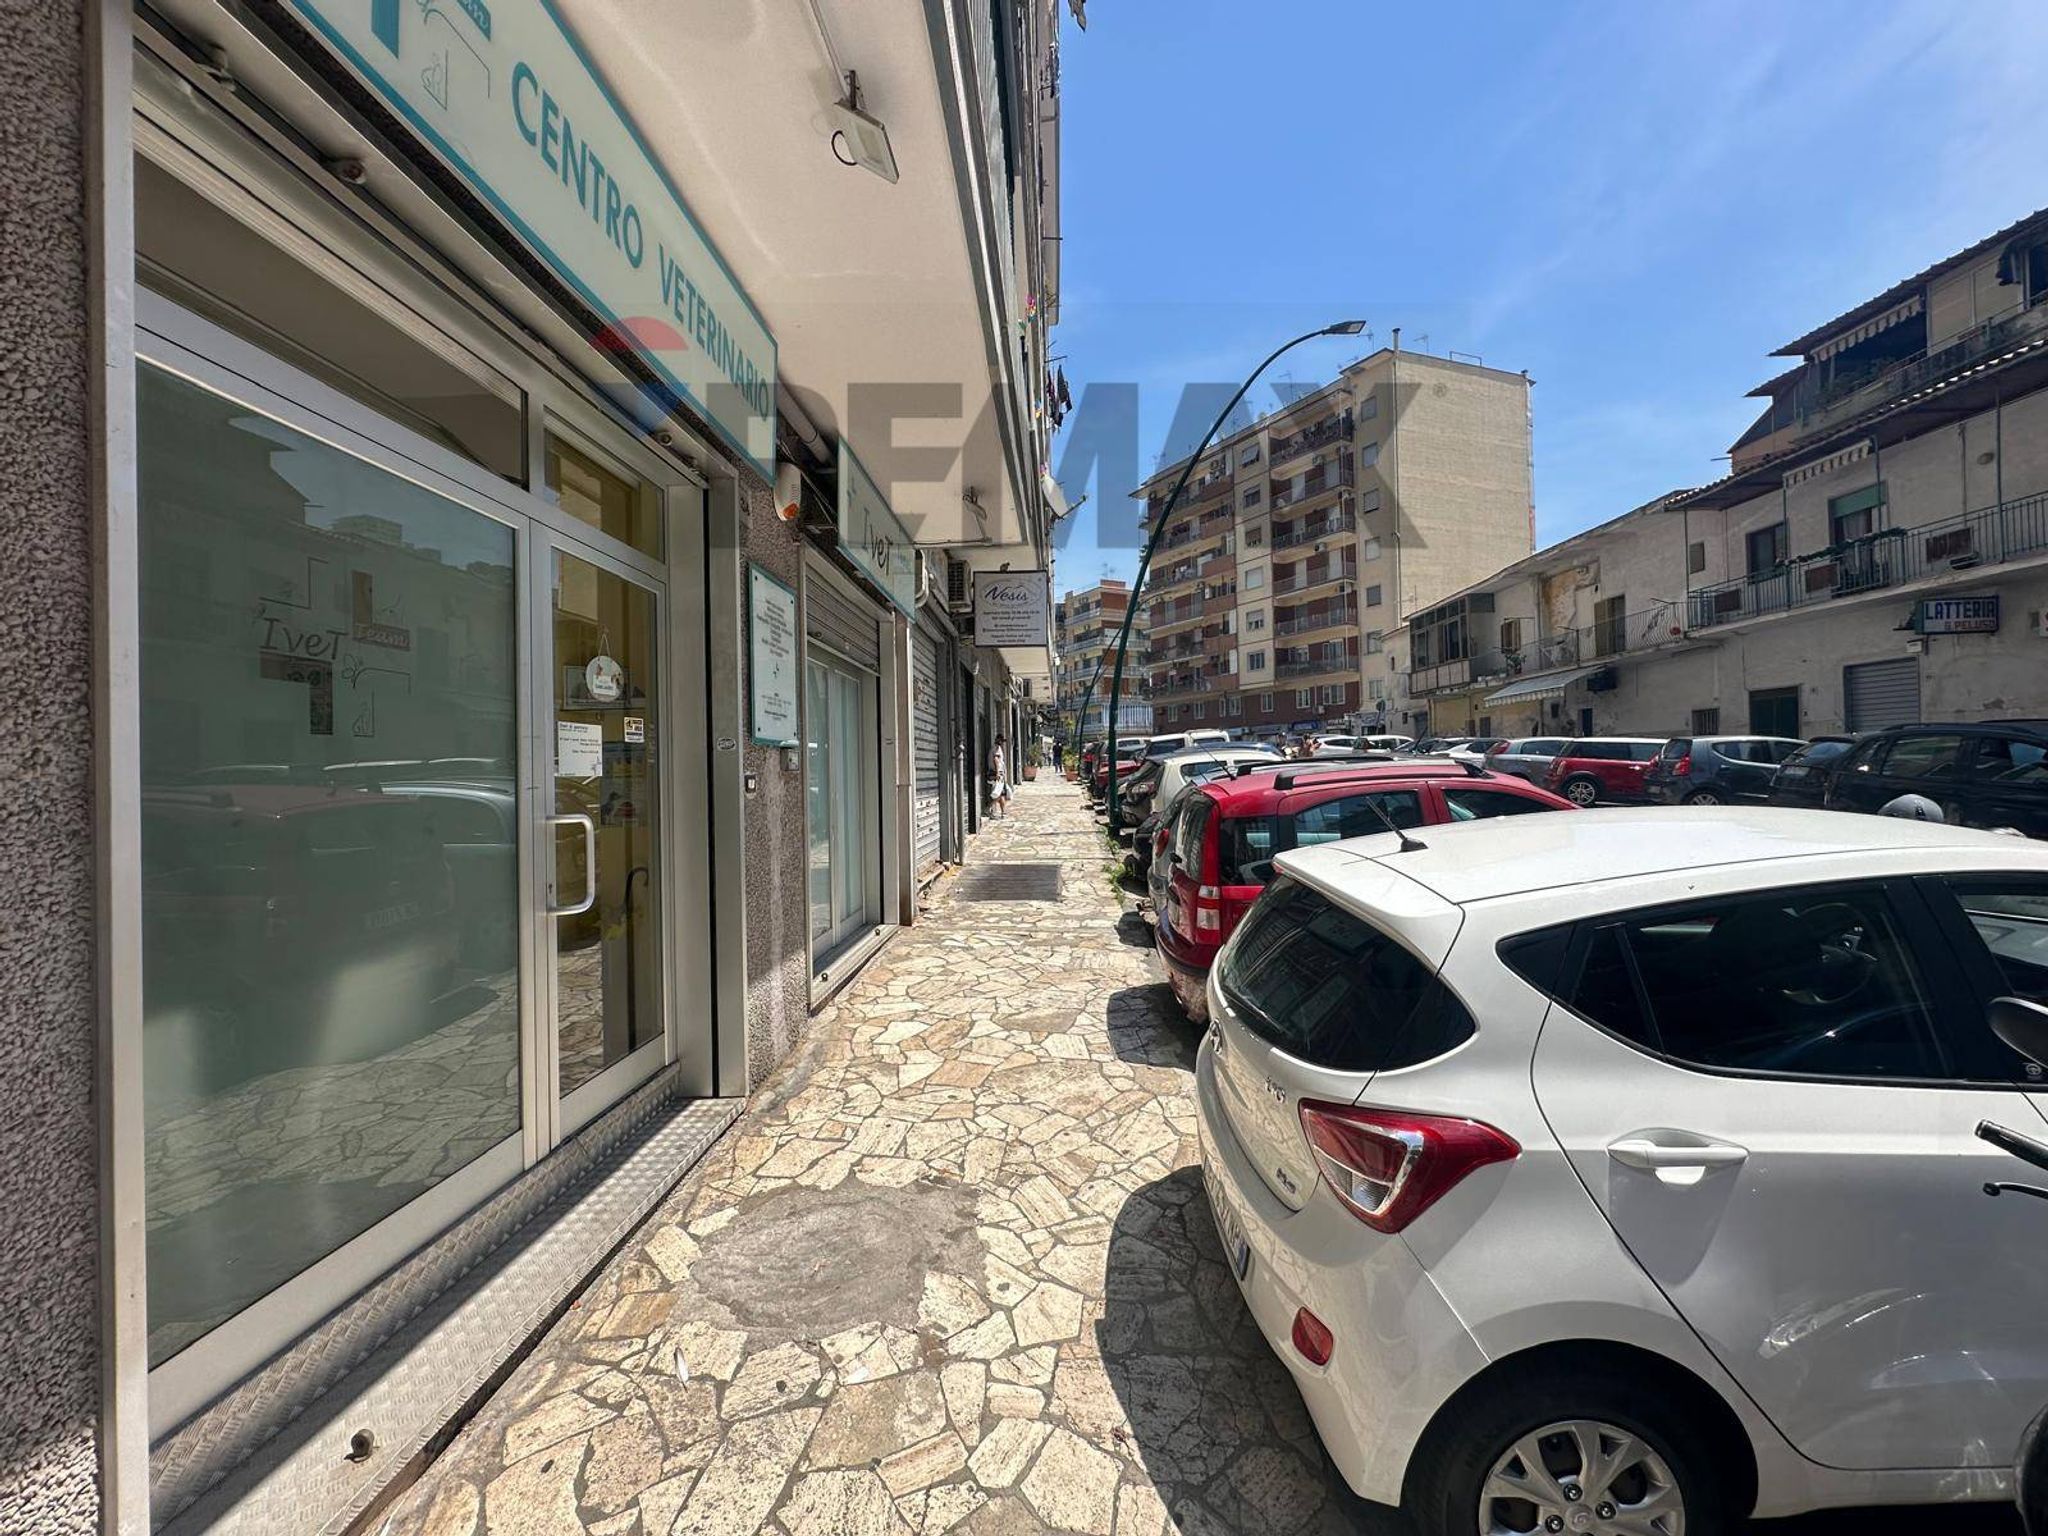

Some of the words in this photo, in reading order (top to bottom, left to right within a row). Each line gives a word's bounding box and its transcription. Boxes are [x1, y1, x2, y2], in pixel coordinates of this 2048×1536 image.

[511, 60, 645, 269] CENTRO
[658, 243, 770, 422] VETERINARIO
[1925, 600, 1995, 620] LATTERIA
